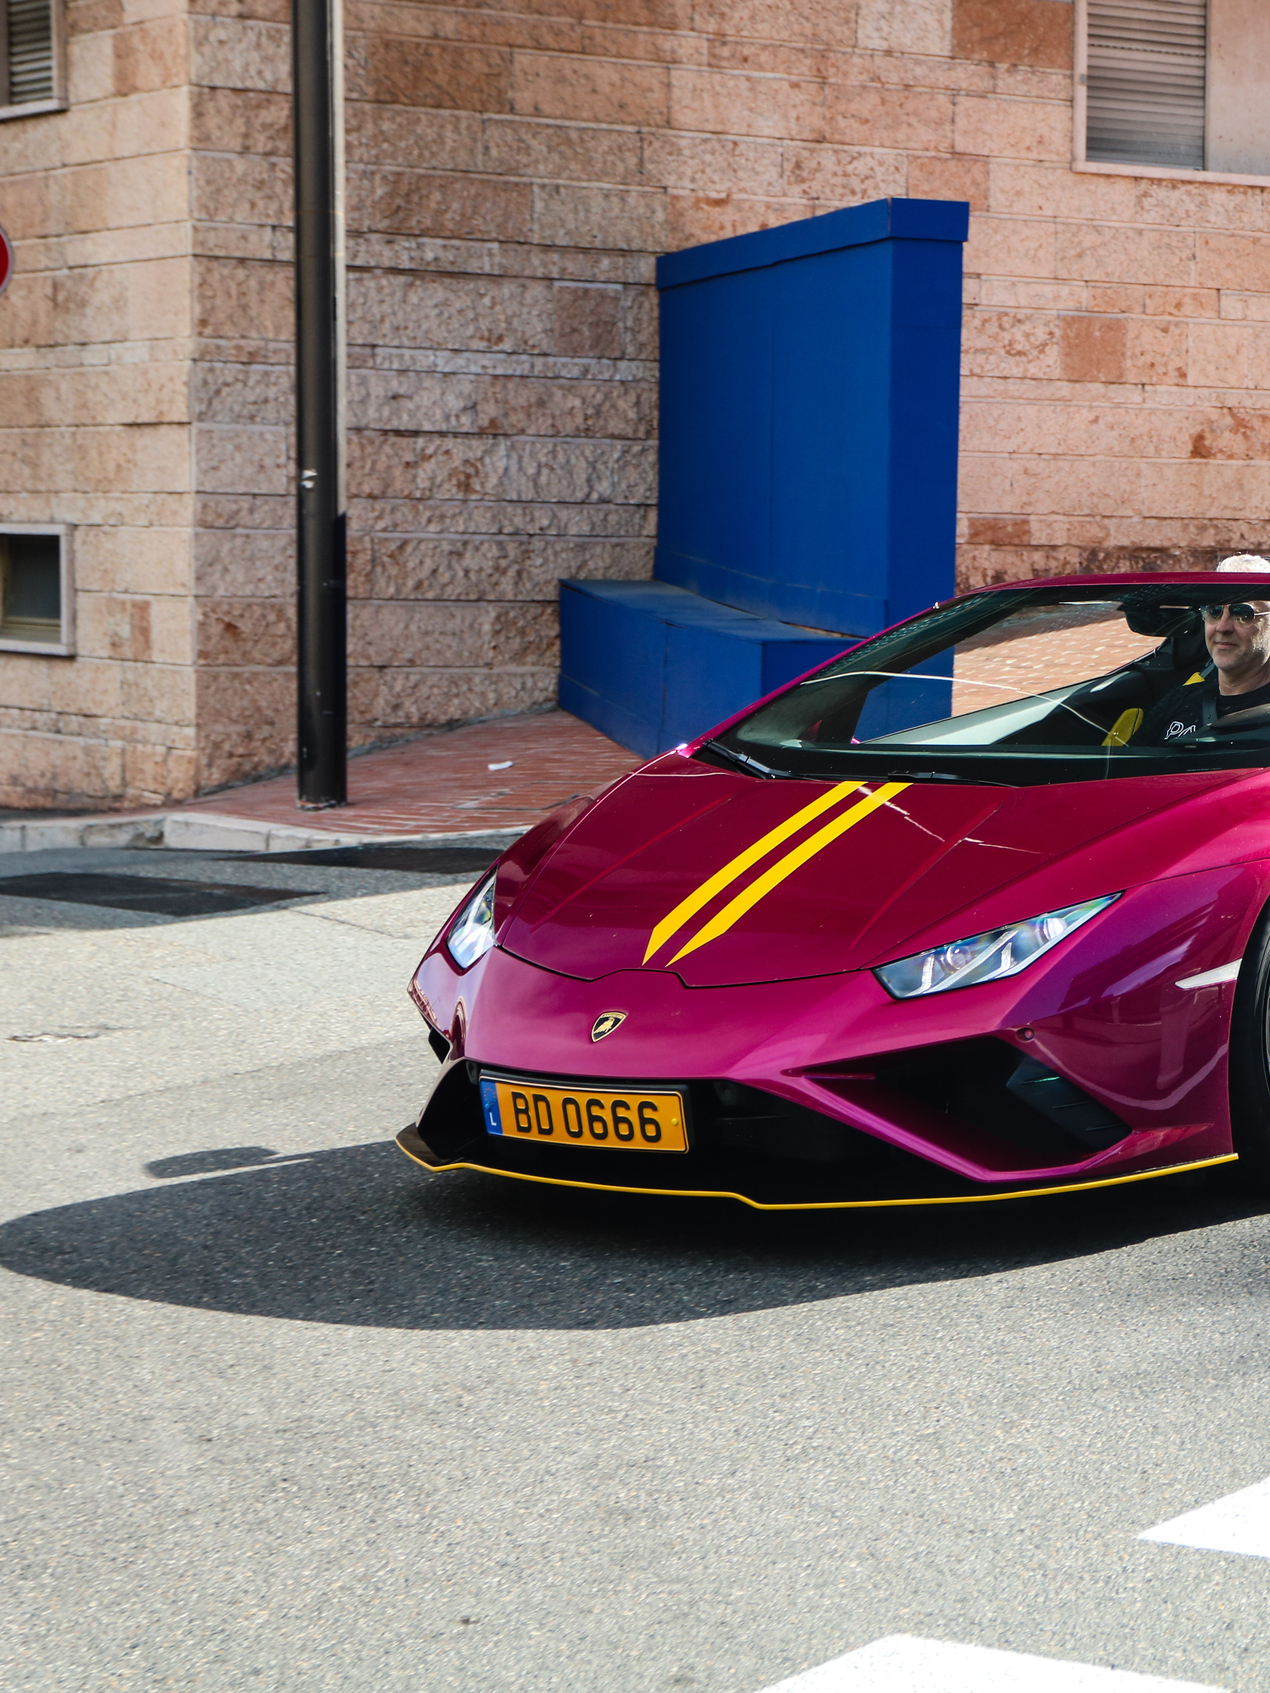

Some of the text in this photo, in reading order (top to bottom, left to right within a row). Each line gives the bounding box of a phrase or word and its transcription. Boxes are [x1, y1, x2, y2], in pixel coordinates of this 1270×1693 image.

[490, 1112, 497, 1126] L
[511, 1091, 662, 1142] BD 0666
